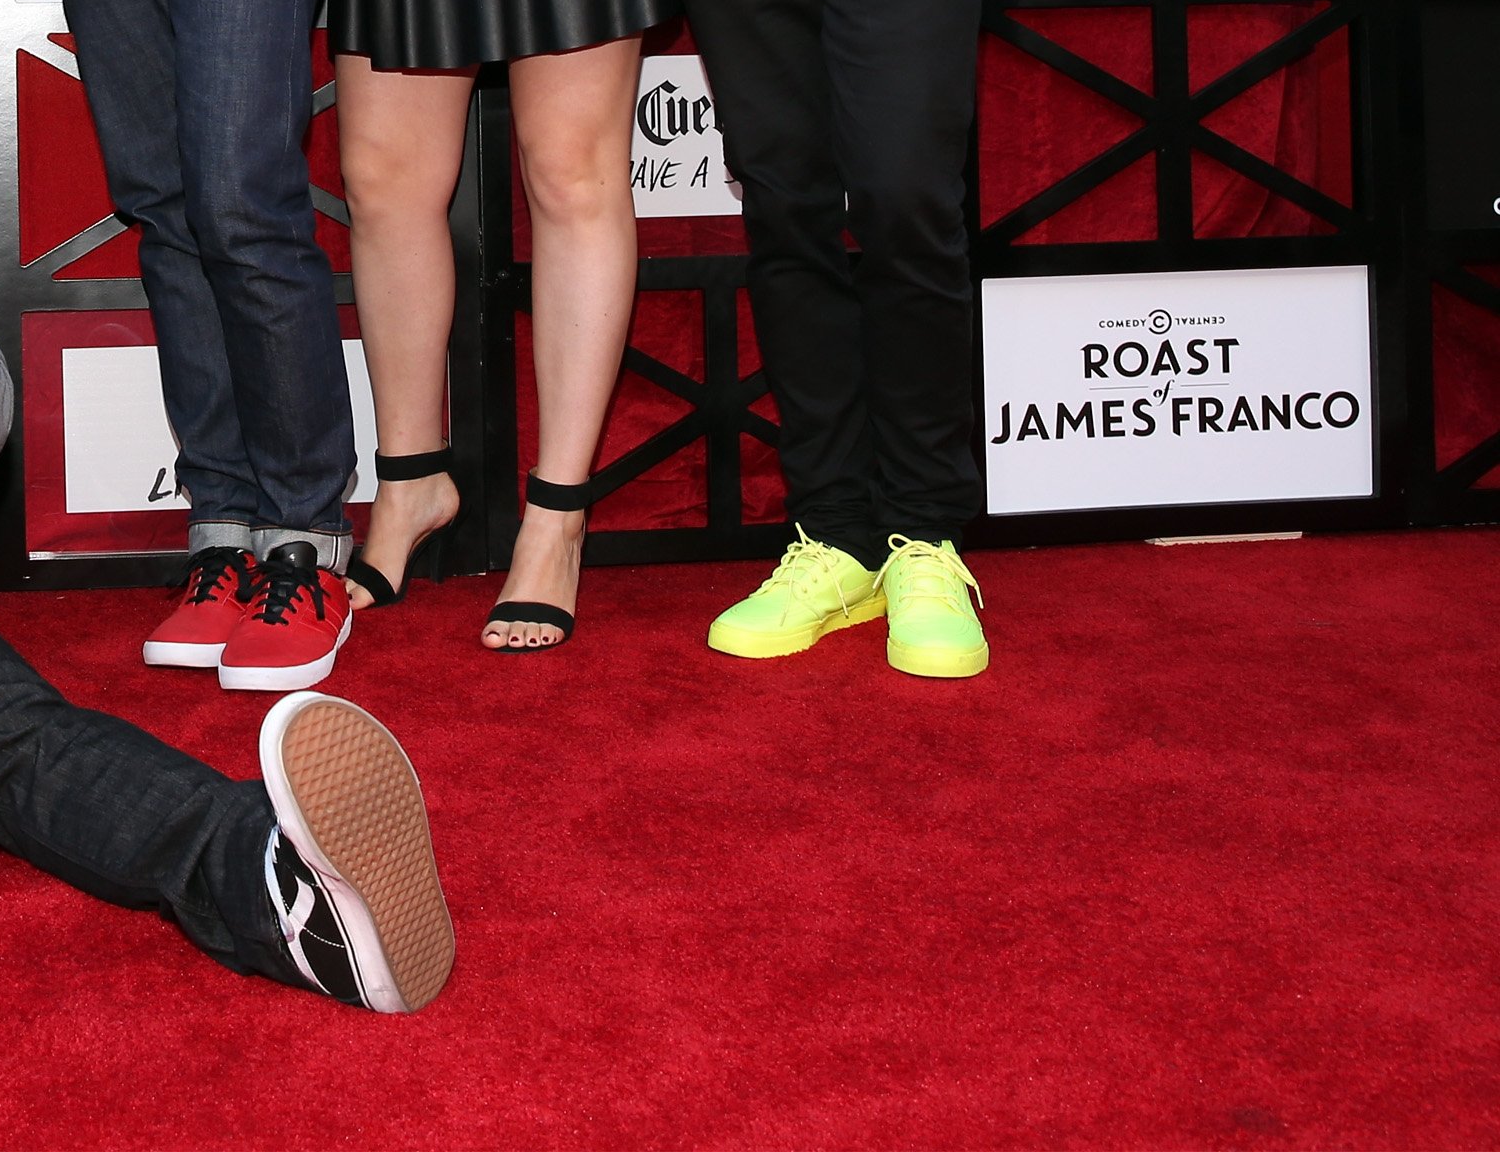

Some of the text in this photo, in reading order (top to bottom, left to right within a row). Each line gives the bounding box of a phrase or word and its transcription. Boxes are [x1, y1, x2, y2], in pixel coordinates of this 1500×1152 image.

[690, 155, 709, 188] A
[1098, 318, 1147, 329] COMEDY
[1080, 338, 1240, 379] ROAST
[1152, 379, 1175, 406] of
[990, 390, 1360, 445] JAMES FRANCO
